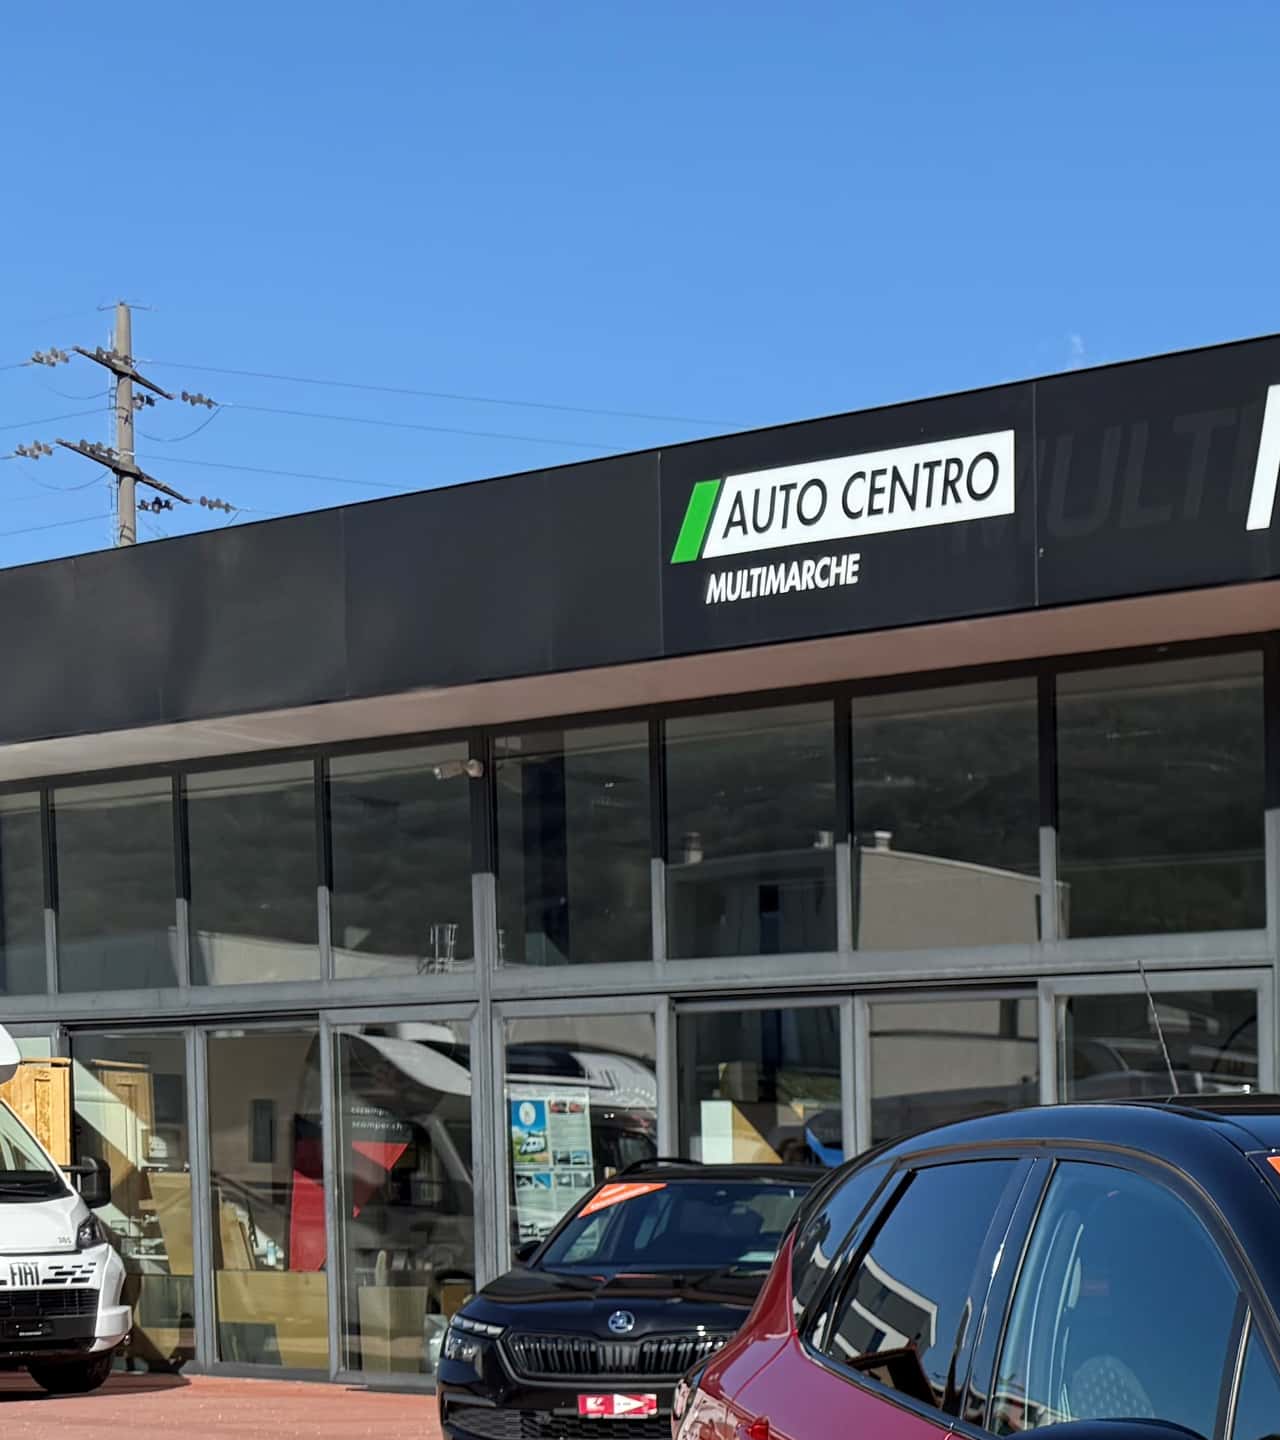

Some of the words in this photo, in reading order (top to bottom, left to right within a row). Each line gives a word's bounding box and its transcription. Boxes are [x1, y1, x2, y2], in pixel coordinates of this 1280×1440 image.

[721, 477, 827, 540] AUTO
[841, 450, 1000, 521] CENTRO
[706, 553, 860, 605] MULTIMARCHE
[9, 1262, 40, 1287] FIAT
